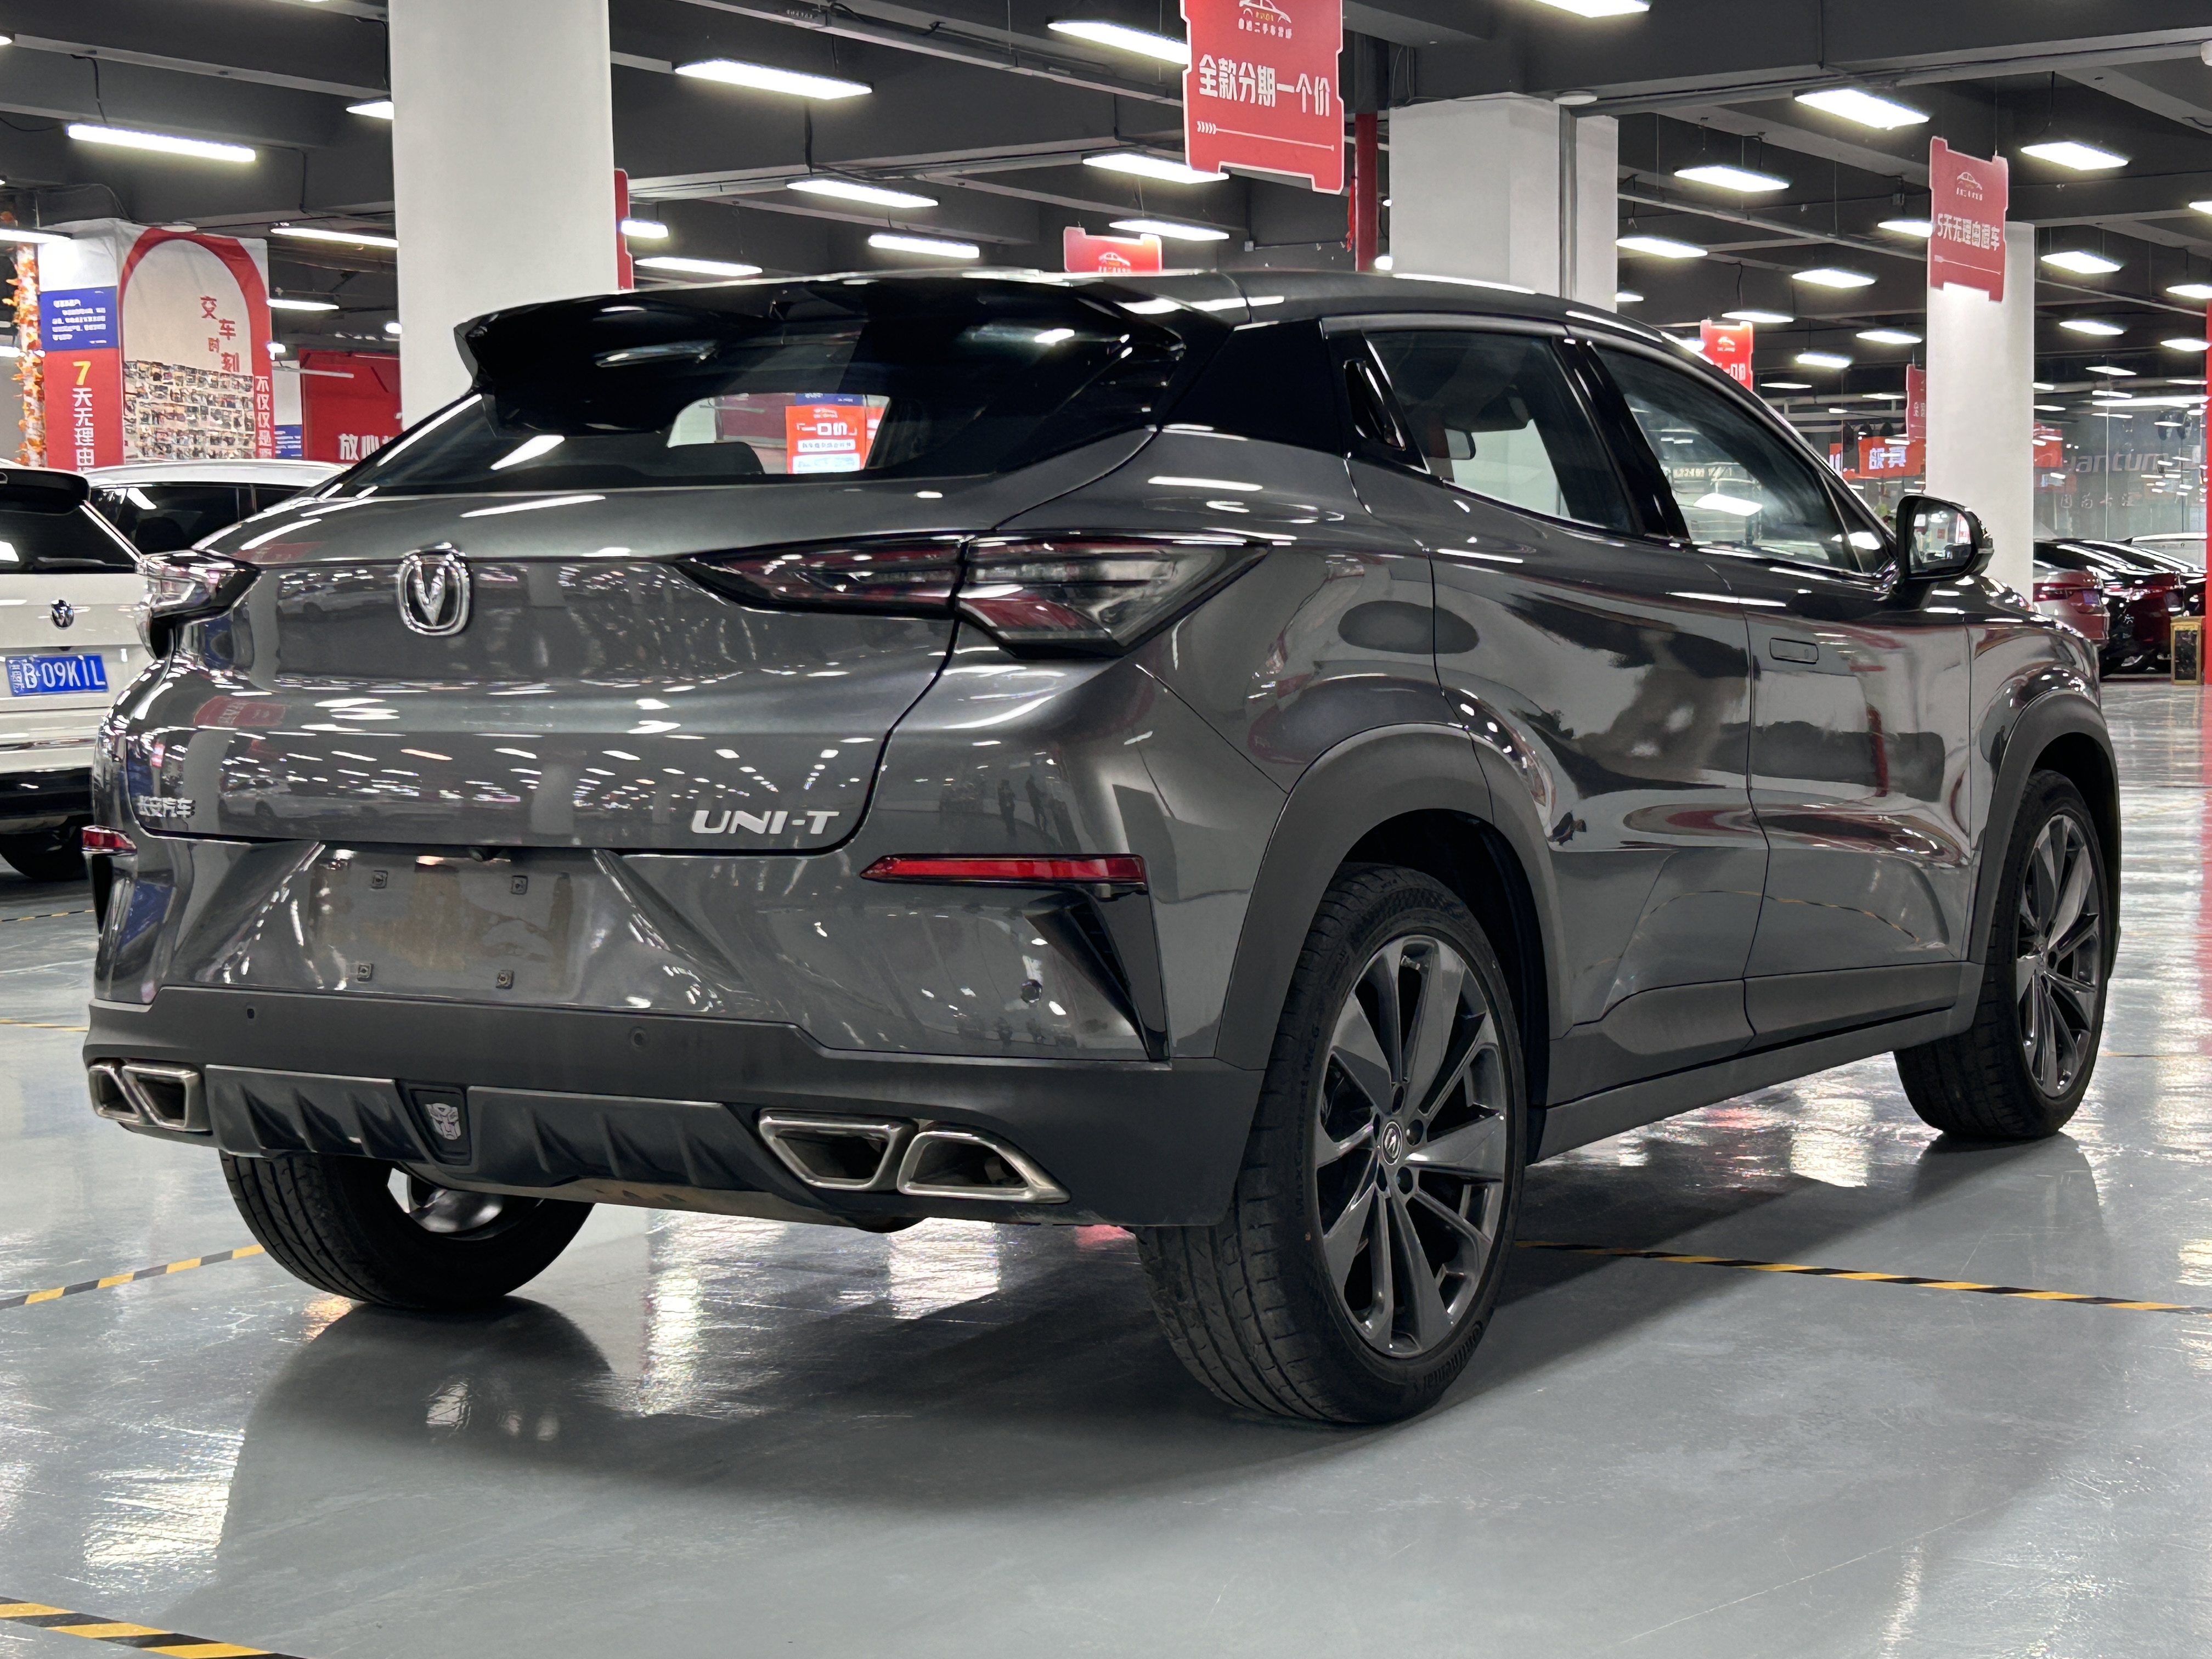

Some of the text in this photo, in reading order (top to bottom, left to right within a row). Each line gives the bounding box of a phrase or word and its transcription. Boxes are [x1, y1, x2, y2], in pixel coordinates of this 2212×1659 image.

[1199, 54, 1331, 117] 全款分期一个价
[691, 810, 840, 834] UNI-T
